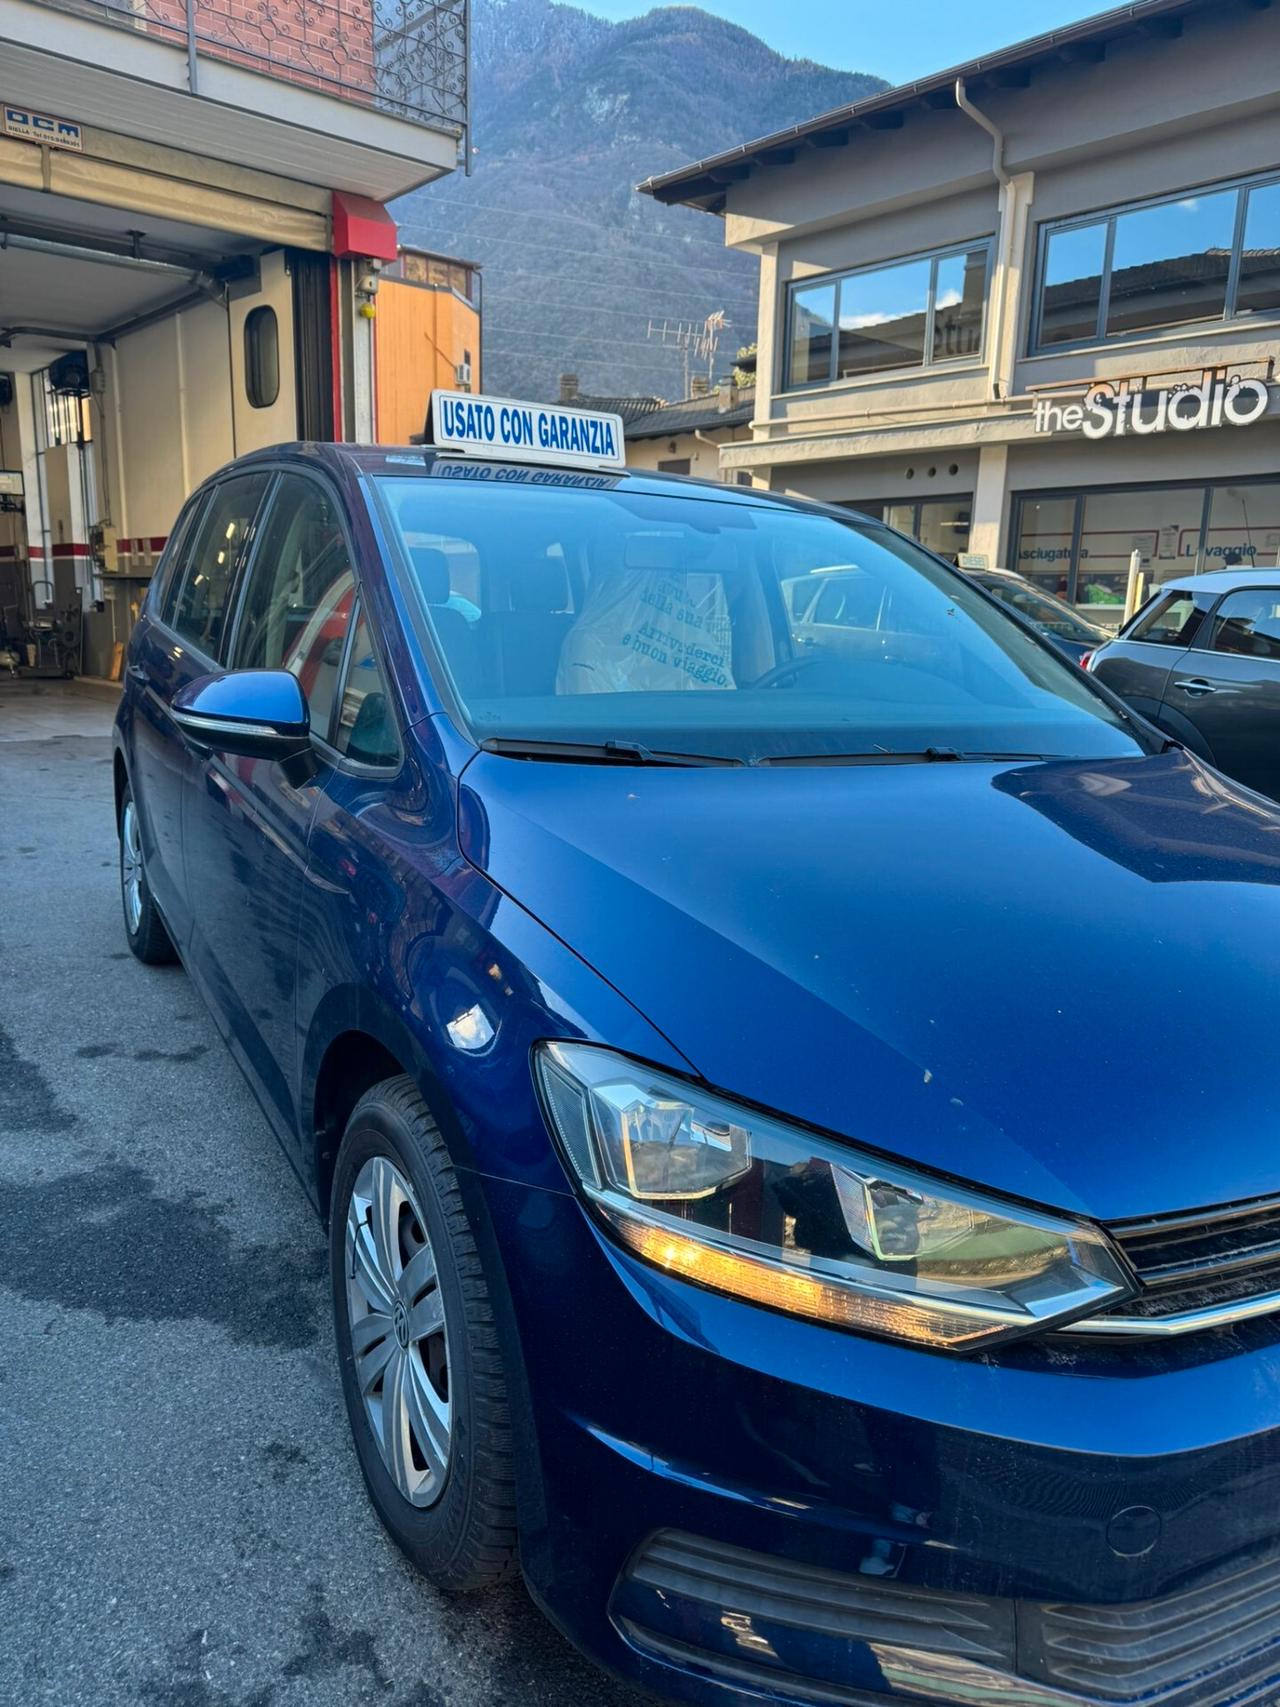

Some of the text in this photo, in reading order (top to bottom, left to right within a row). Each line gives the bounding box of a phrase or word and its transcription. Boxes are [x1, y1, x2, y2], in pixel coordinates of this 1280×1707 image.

[443, 400, 615, 456] USATO CON GARANZIA
[1185, 542, 1257, 558] Lvaggio
[632, 634, 668, 664] buon
